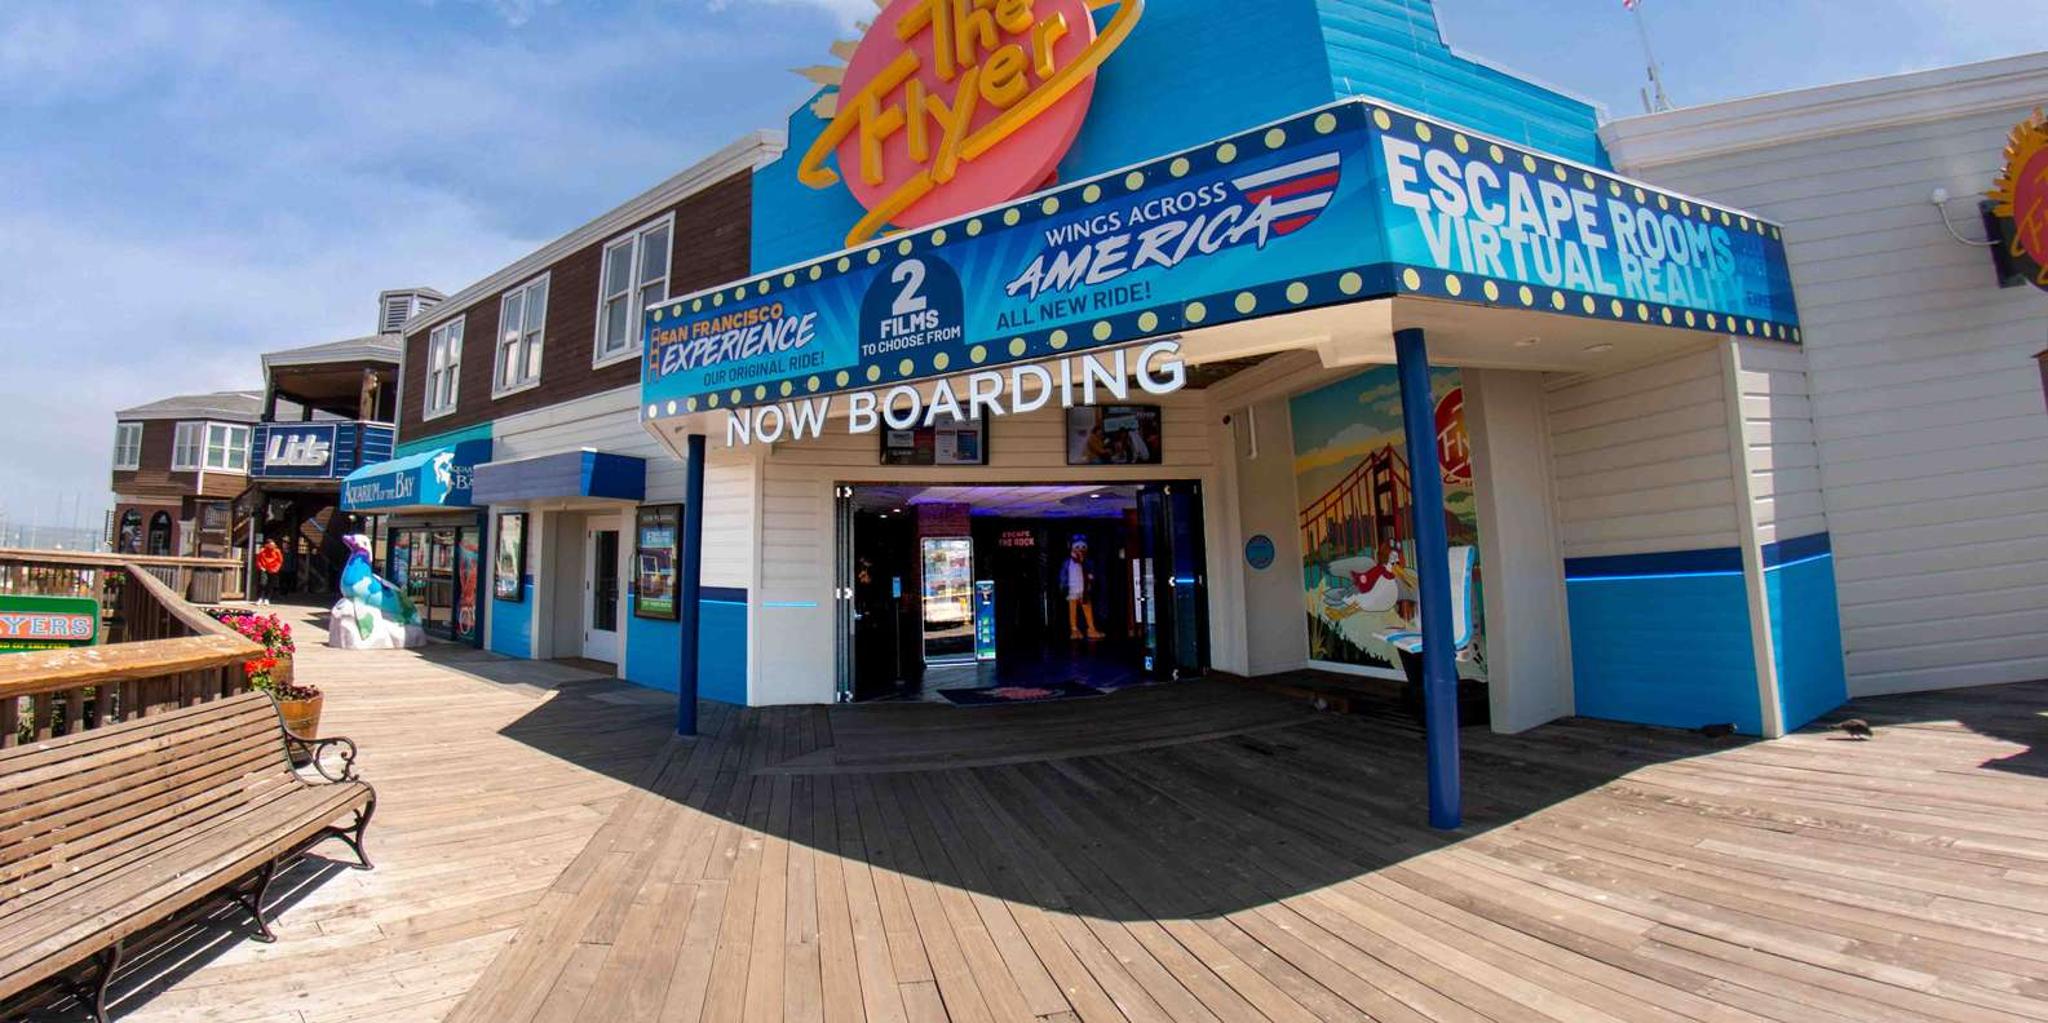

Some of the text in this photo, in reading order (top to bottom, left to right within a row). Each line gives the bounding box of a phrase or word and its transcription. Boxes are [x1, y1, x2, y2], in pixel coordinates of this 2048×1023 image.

[896, 0, 1034, 81] The
[798, 11, 1069, 188] Flyer
[1045, 181, 1227, 248] WINGS ACROSS
[1381, 134, 1607, 250] ESCAPE
[1607, 198, 1736, 279] ROOMS
[1005, 195, 1275, 301] AMERICA
[1414, 206, 1619, 295] VIRTUAL
[1618, 249, 1745, 317] REALITY
[891, 258, 927, 316] 2
[996, 281, 1151, 331] ALL NEW RIDE!
[659, 302, 783, 346] SAN FRANCISCO
[661, 312, 817, 376] EXPERIENCE
[862, 325, 961, 357] TO CHOOSE FROM
[881, 309, 939, 339] FILMS
[703, 351, 825, 387] OUR ORIGINAL RIDE!
[725, 340, 1188, 448] NOW BOARDING
[265, 434, 330, 467] Lids
[344, 480, 380, 509] AQUARIUM
[395, 471, 415, 498] BAY
[0, 614, 89, 636] YERS
